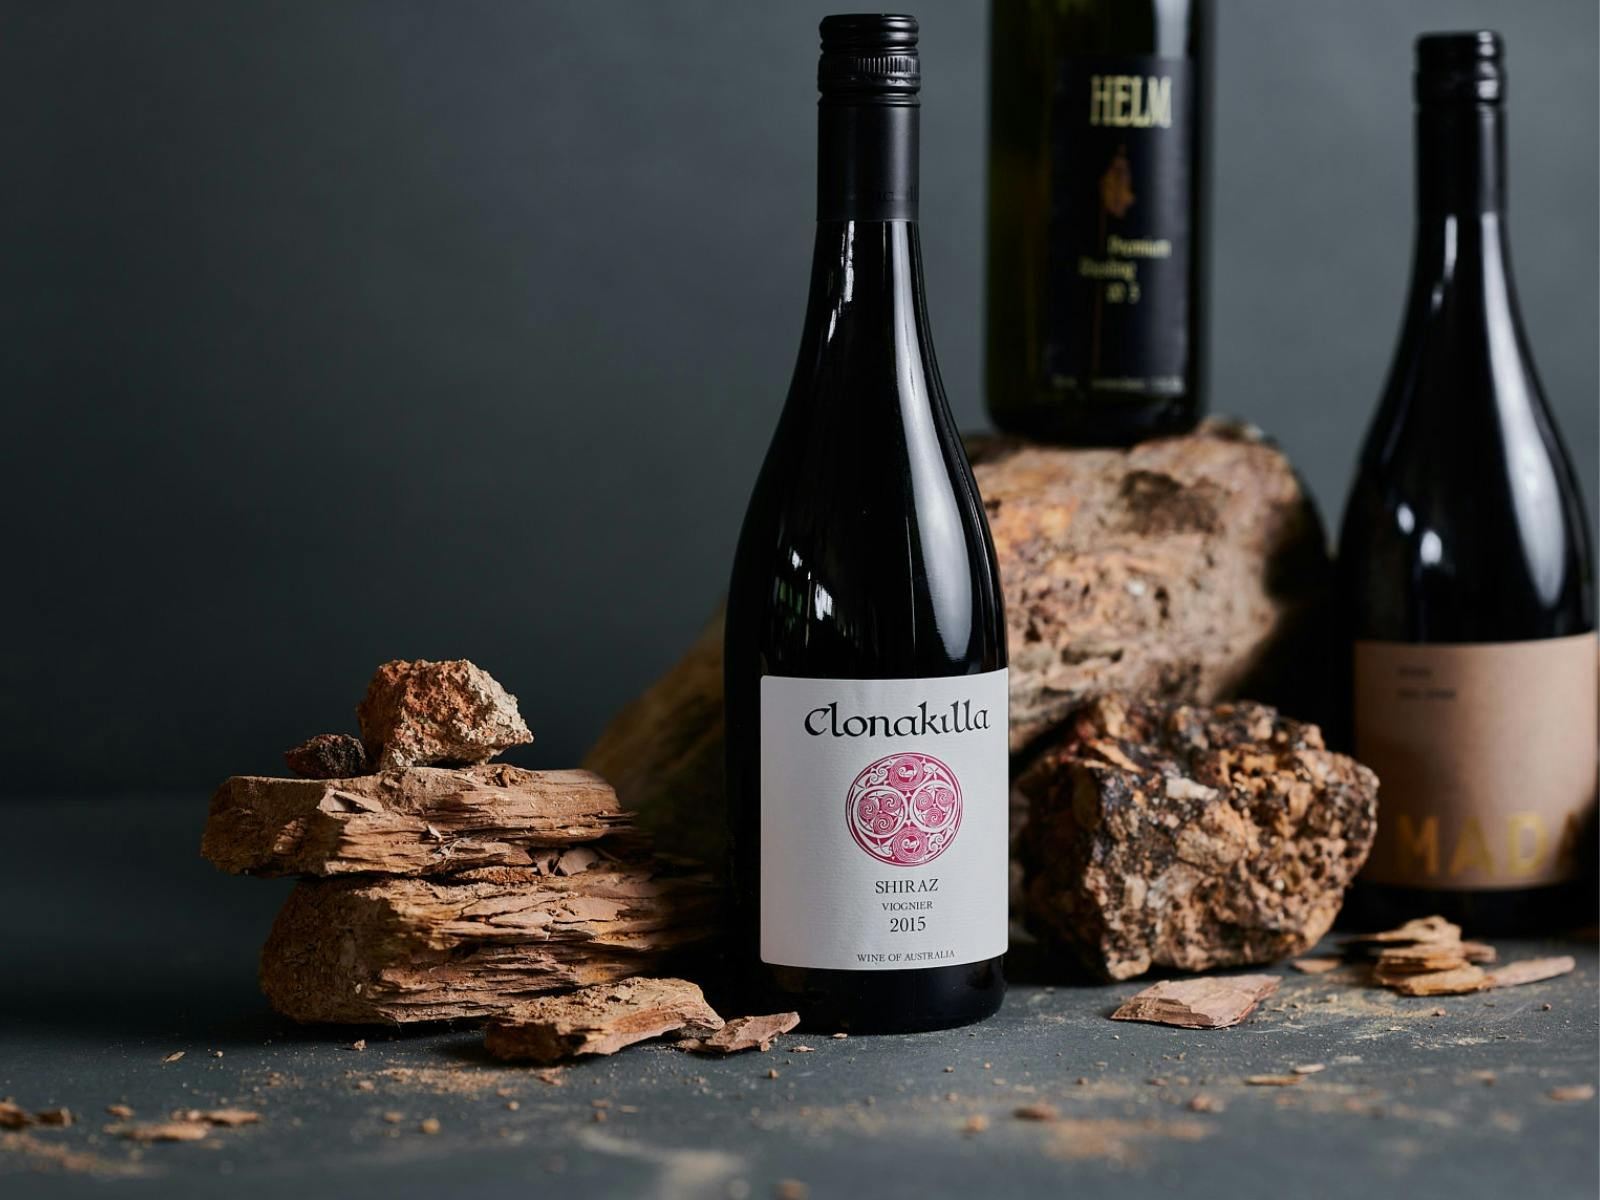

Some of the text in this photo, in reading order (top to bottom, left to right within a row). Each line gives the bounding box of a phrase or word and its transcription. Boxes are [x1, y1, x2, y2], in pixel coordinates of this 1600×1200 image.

[1090, 75, 1172, 128] HELM
[804, 700, 991, 738] Clonakilla
[875, 878, 939, 895] SHIRAZ
[882, 900, 933, 912] VIOGNIER
[890, 917, 926, 933] 2015
[857, 950, 955, 963] WINE OF AUSTRALIA
